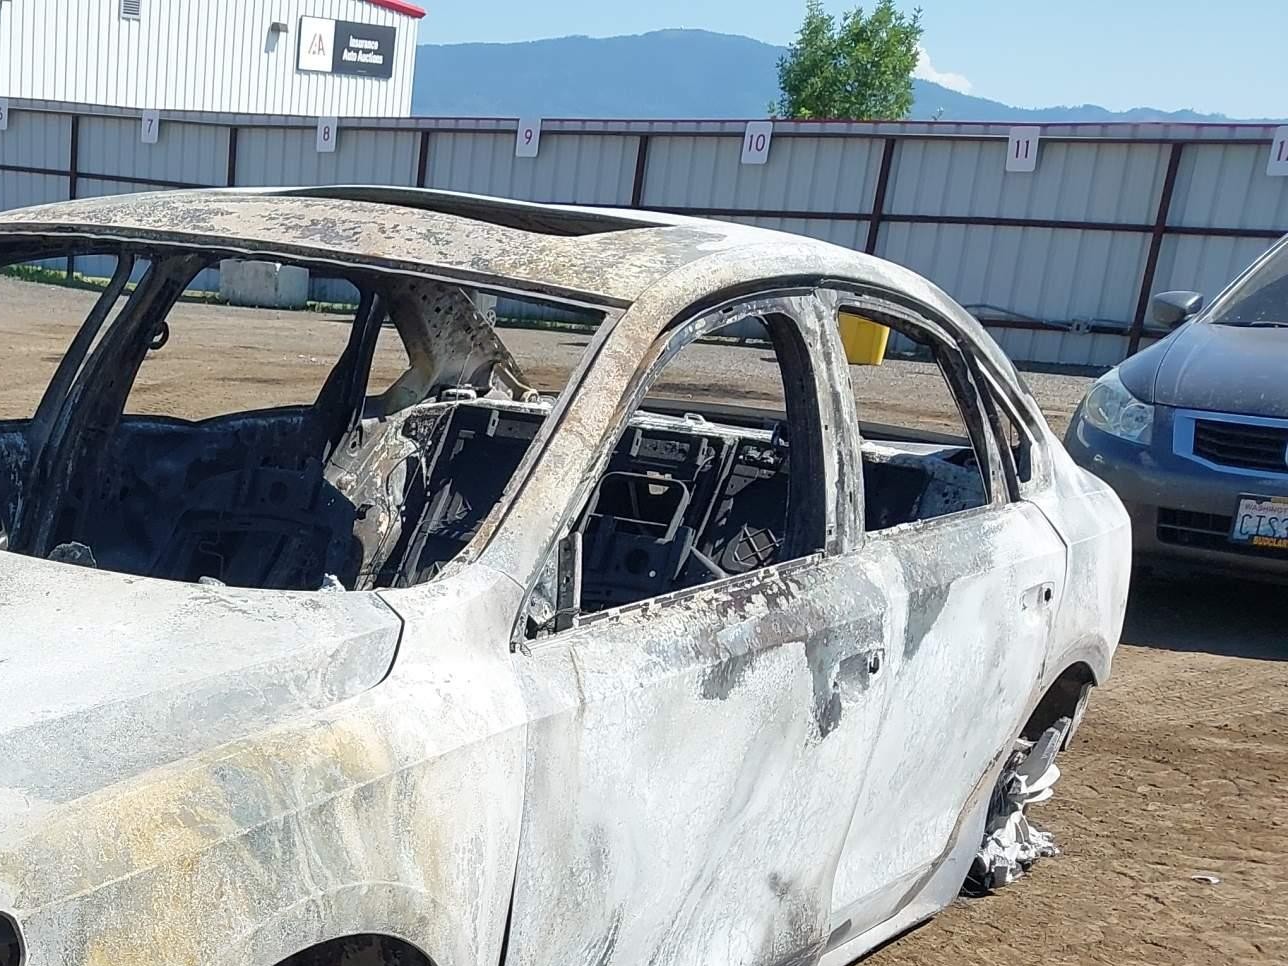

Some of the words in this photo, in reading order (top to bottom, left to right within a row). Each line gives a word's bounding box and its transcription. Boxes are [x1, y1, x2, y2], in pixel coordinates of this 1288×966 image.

[349, 34, 379, 50] Insurance
[342, 48, 357, 61] Auto
[357, 50, 384, 65] Auctions
[147, 118, 153, 135] 7
[323, 126, 330, 141] 8
[524, 128, 533, 145] 9
[748, 133, 766, 152] 10
[1015, 139, 1030, 159] 11
[1277, 140, 1288, 162] 1
